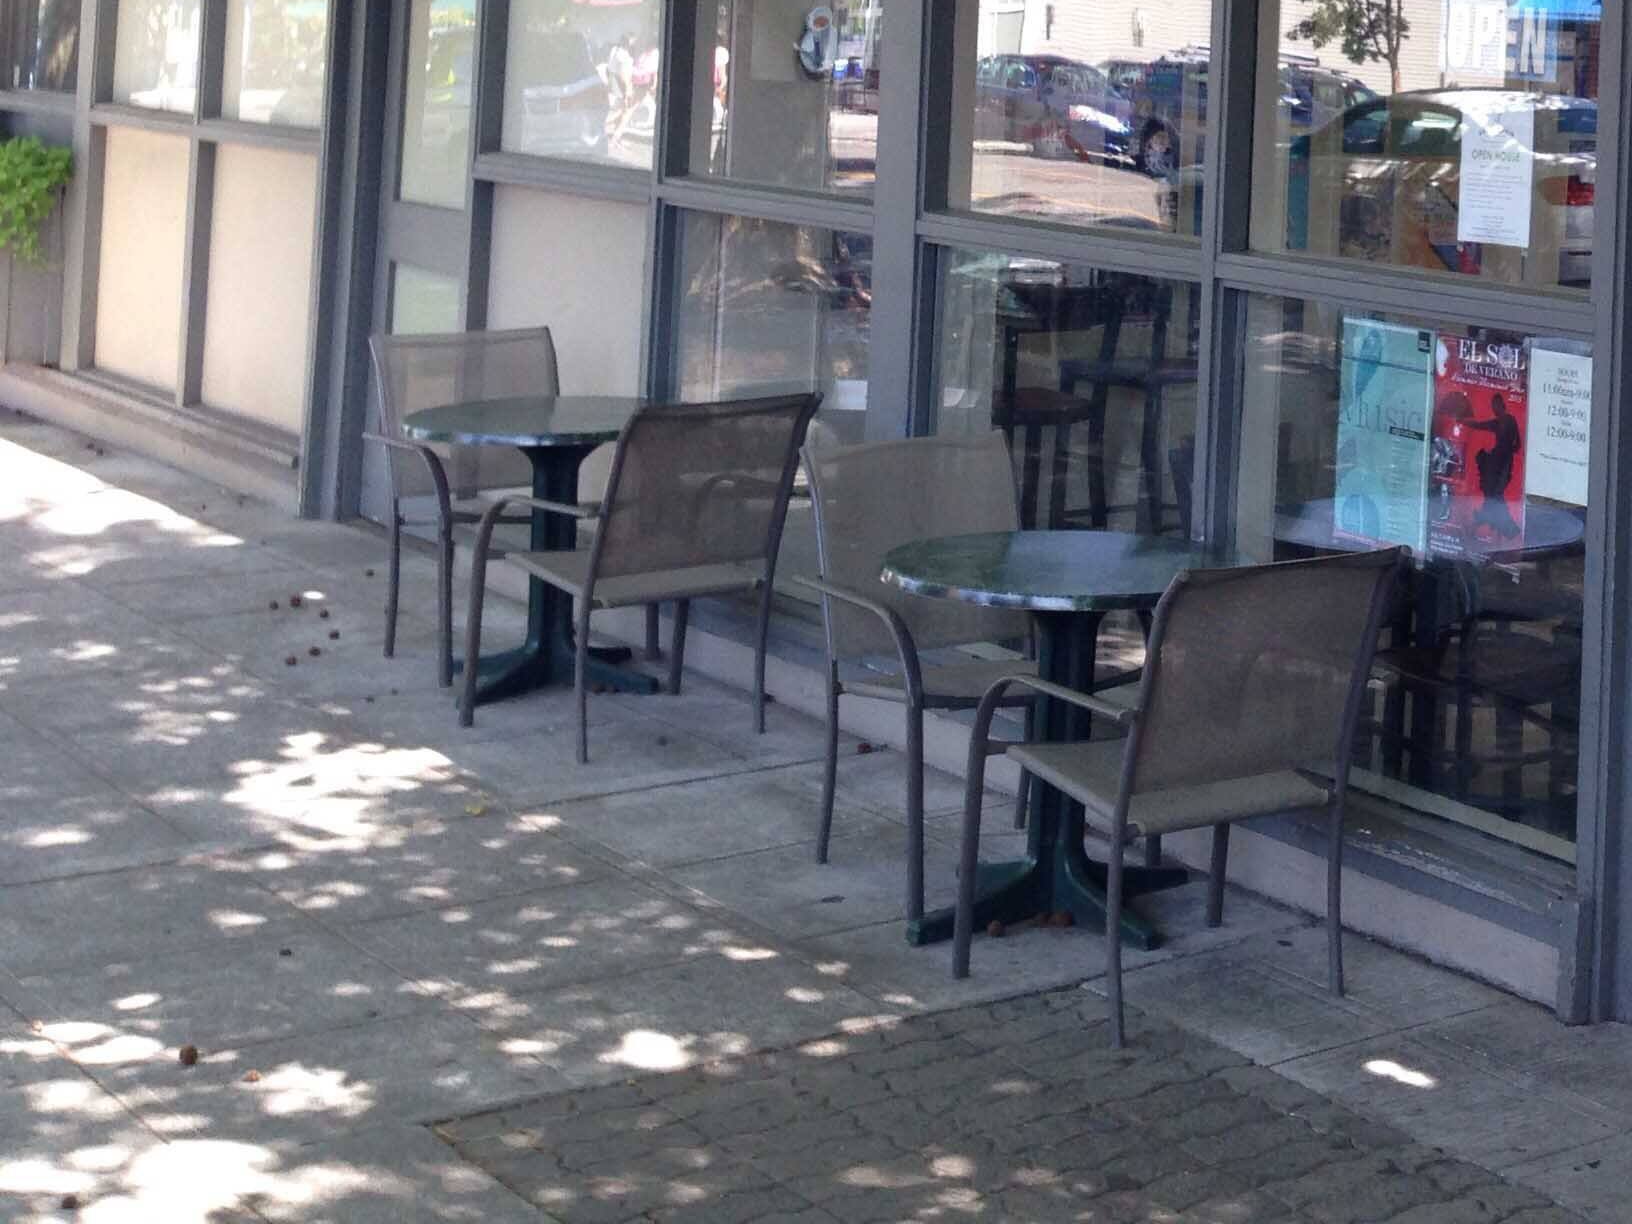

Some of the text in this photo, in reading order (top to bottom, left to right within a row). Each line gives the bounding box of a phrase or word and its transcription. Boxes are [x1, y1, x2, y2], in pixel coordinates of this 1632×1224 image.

[1472, 150, 1493, 162] OPEN
[1459, 338, 1526, 370] EL SOL
[1465, 363, 1518, 382] DE VERANO
